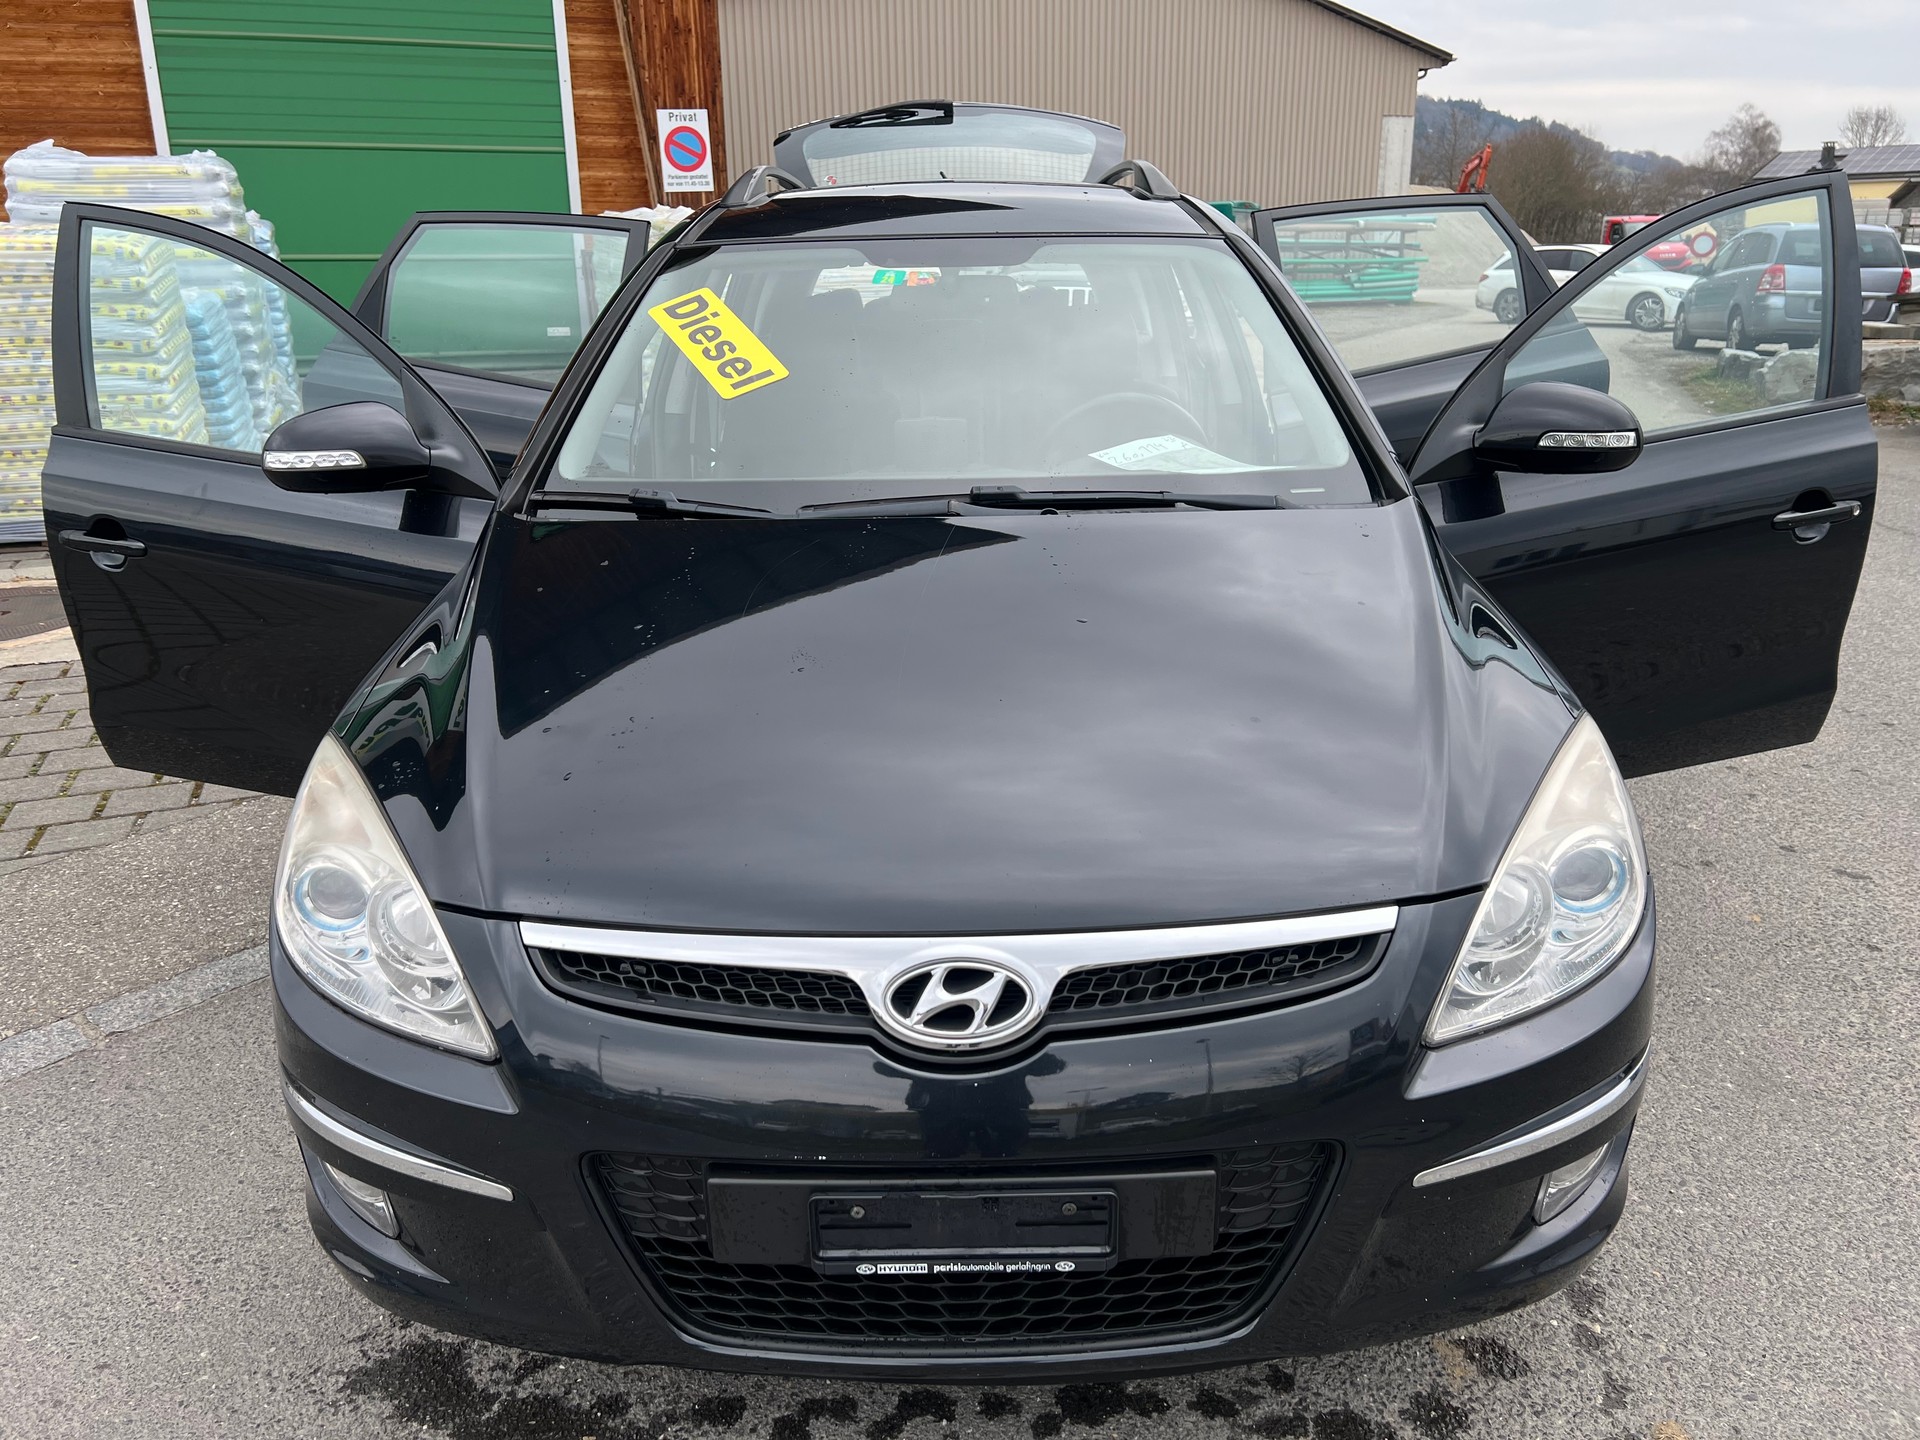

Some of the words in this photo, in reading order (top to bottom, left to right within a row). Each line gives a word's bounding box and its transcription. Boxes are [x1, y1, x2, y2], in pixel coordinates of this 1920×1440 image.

[669, 112, 697, 122] Privat
[663, 294, 775, 390] Diesel
[878, 1264, 927, 1273] HYUNDAI
